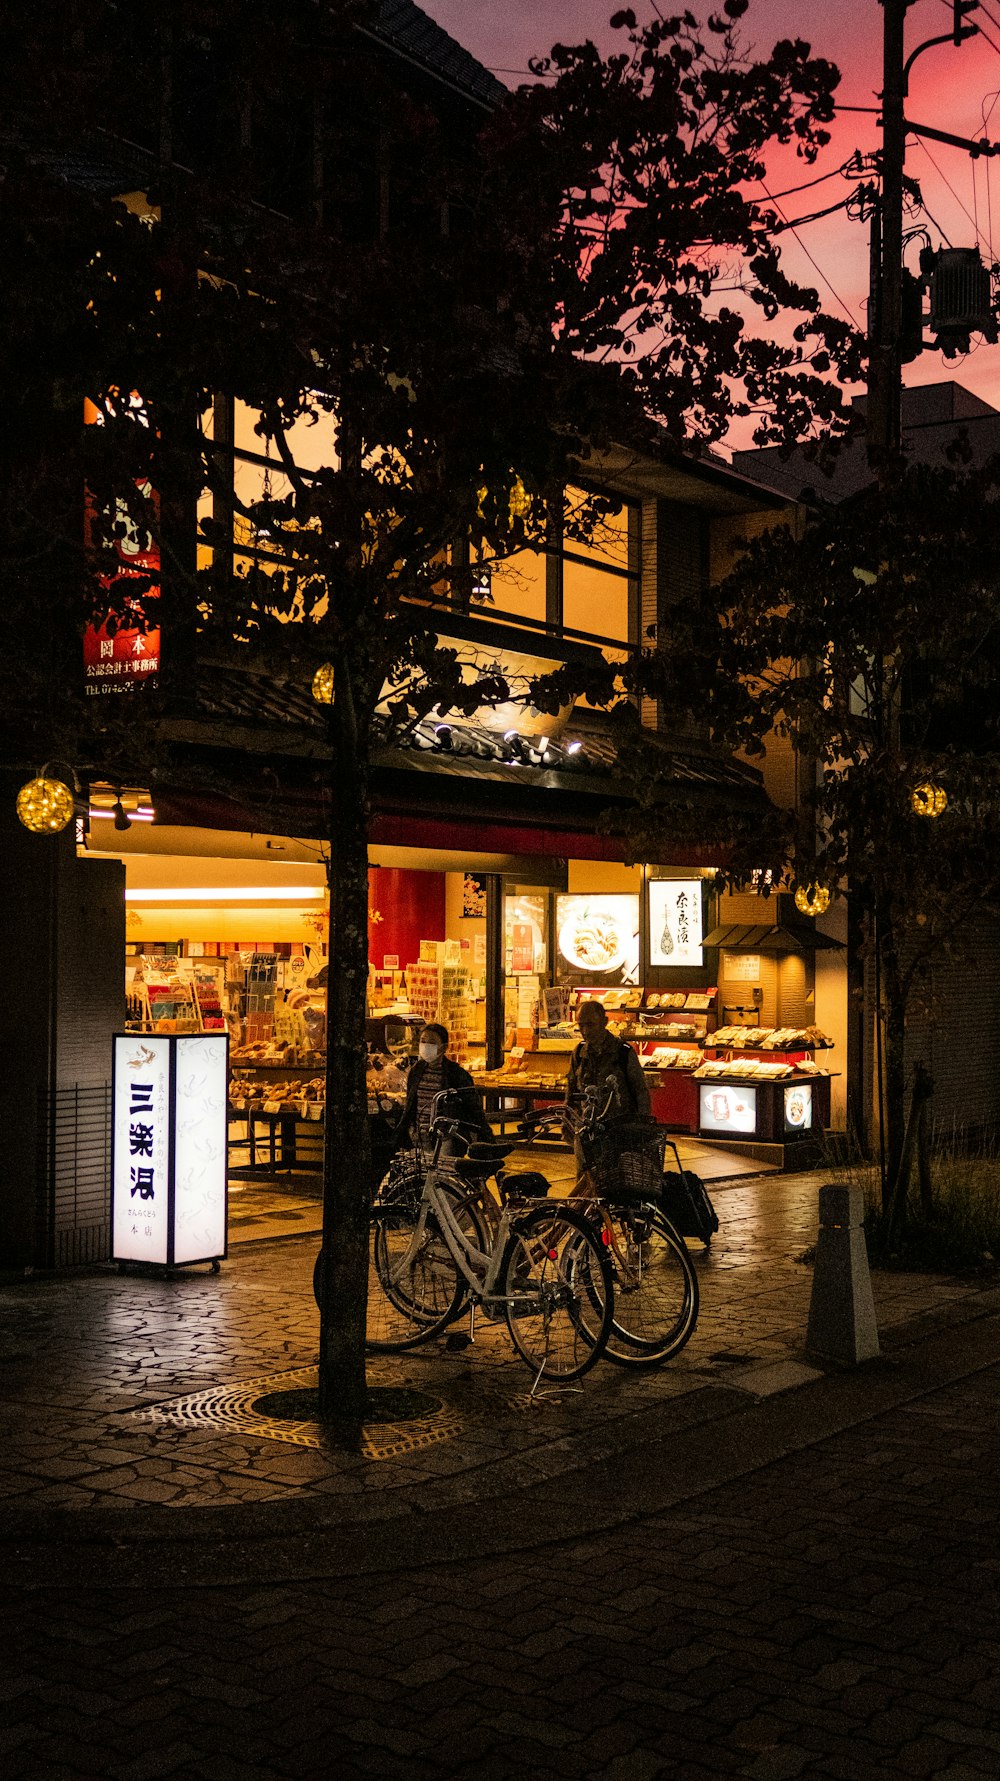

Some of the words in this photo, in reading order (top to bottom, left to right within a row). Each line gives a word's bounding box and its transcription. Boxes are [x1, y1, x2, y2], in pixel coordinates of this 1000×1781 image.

[86, 657, 159, 677] 公認会計士事務所
[84, 684, 101, 696] TEL
[127, 1208, 156, 1218] さんらくどう
